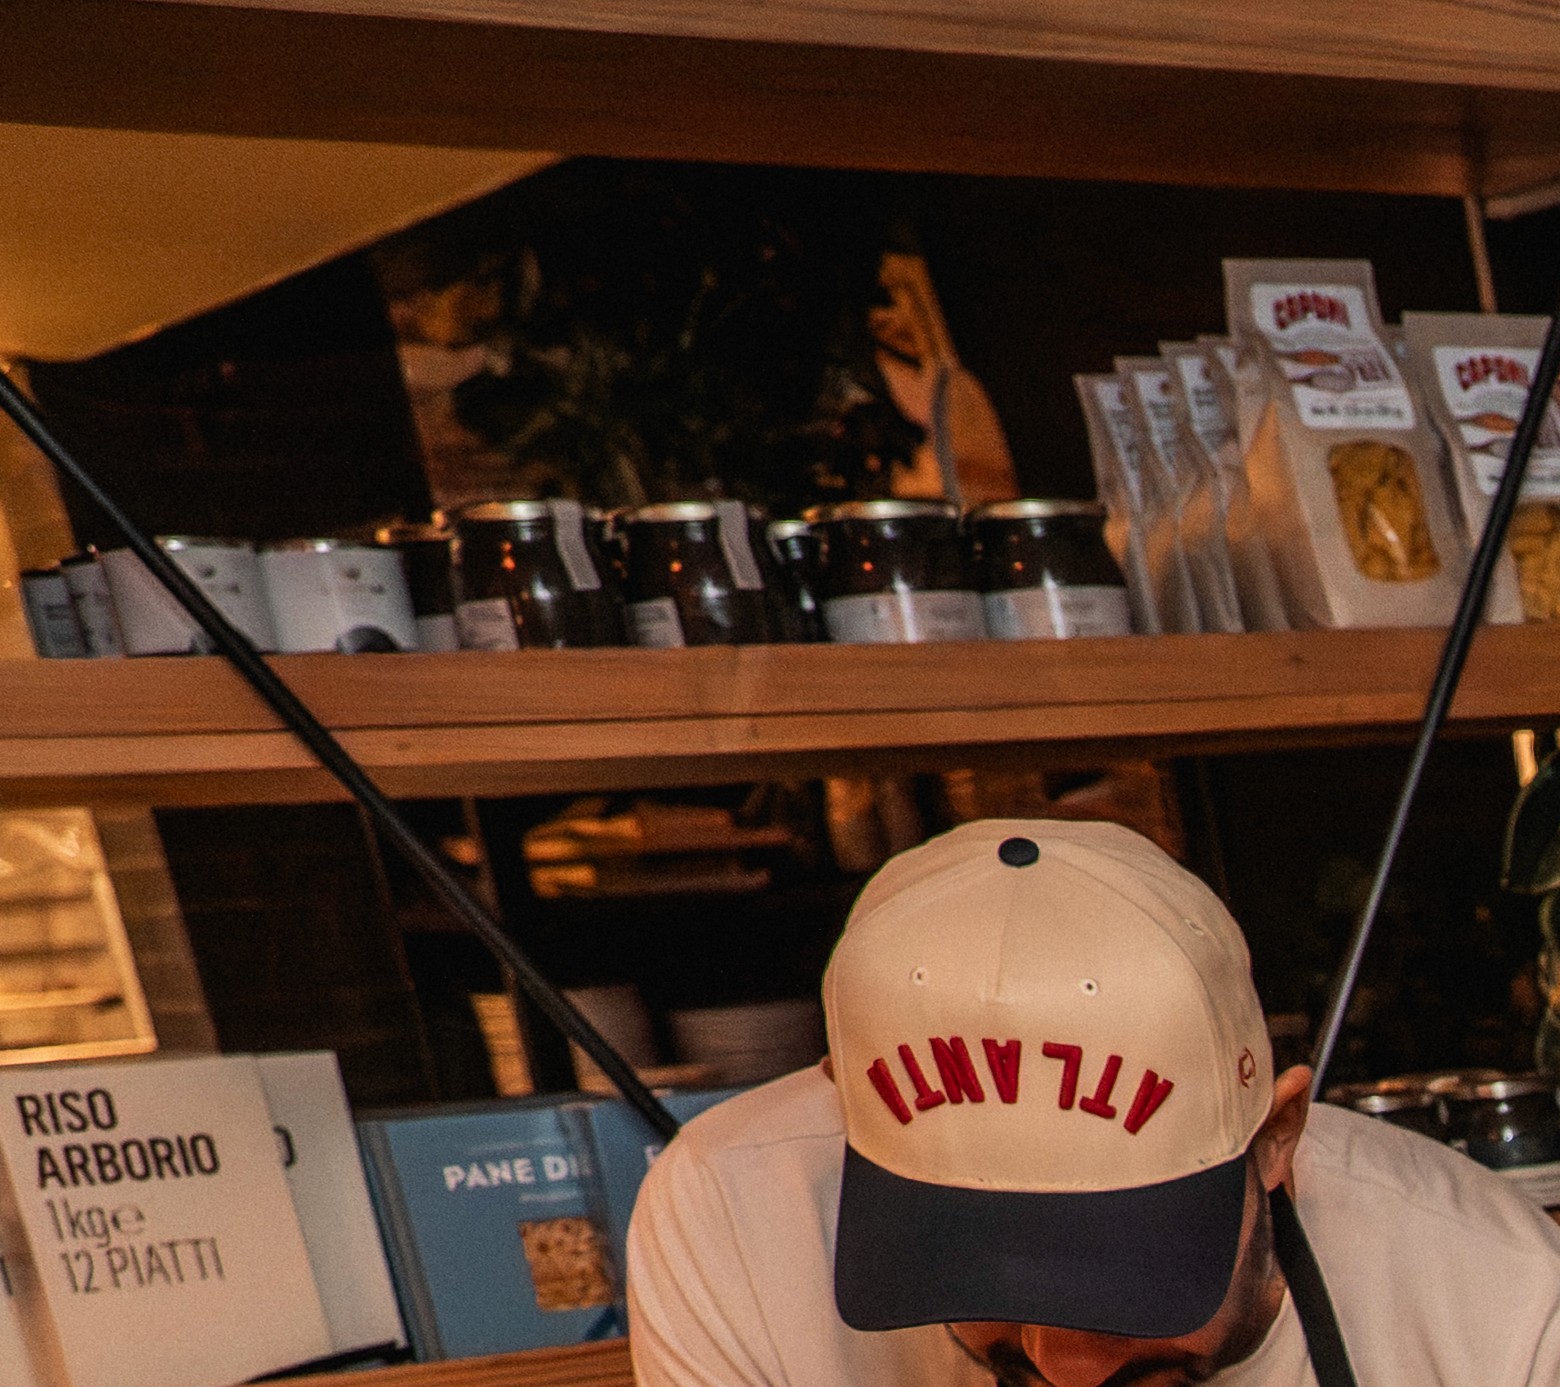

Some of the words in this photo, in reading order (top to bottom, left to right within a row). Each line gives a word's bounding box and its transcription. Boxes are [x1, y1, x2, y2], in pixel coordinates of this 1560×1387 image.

[15, 1088, 118, 1137] RISO
[866, 1036, 1175, 1136] ATLANTA
[37, 1132, 220, 1190] ARBORIO
[443, 1158, 535, 1192] PANE
[61, 1250, 100, 1294] 12
[106, 1236, 226, 1289] PIATTI
